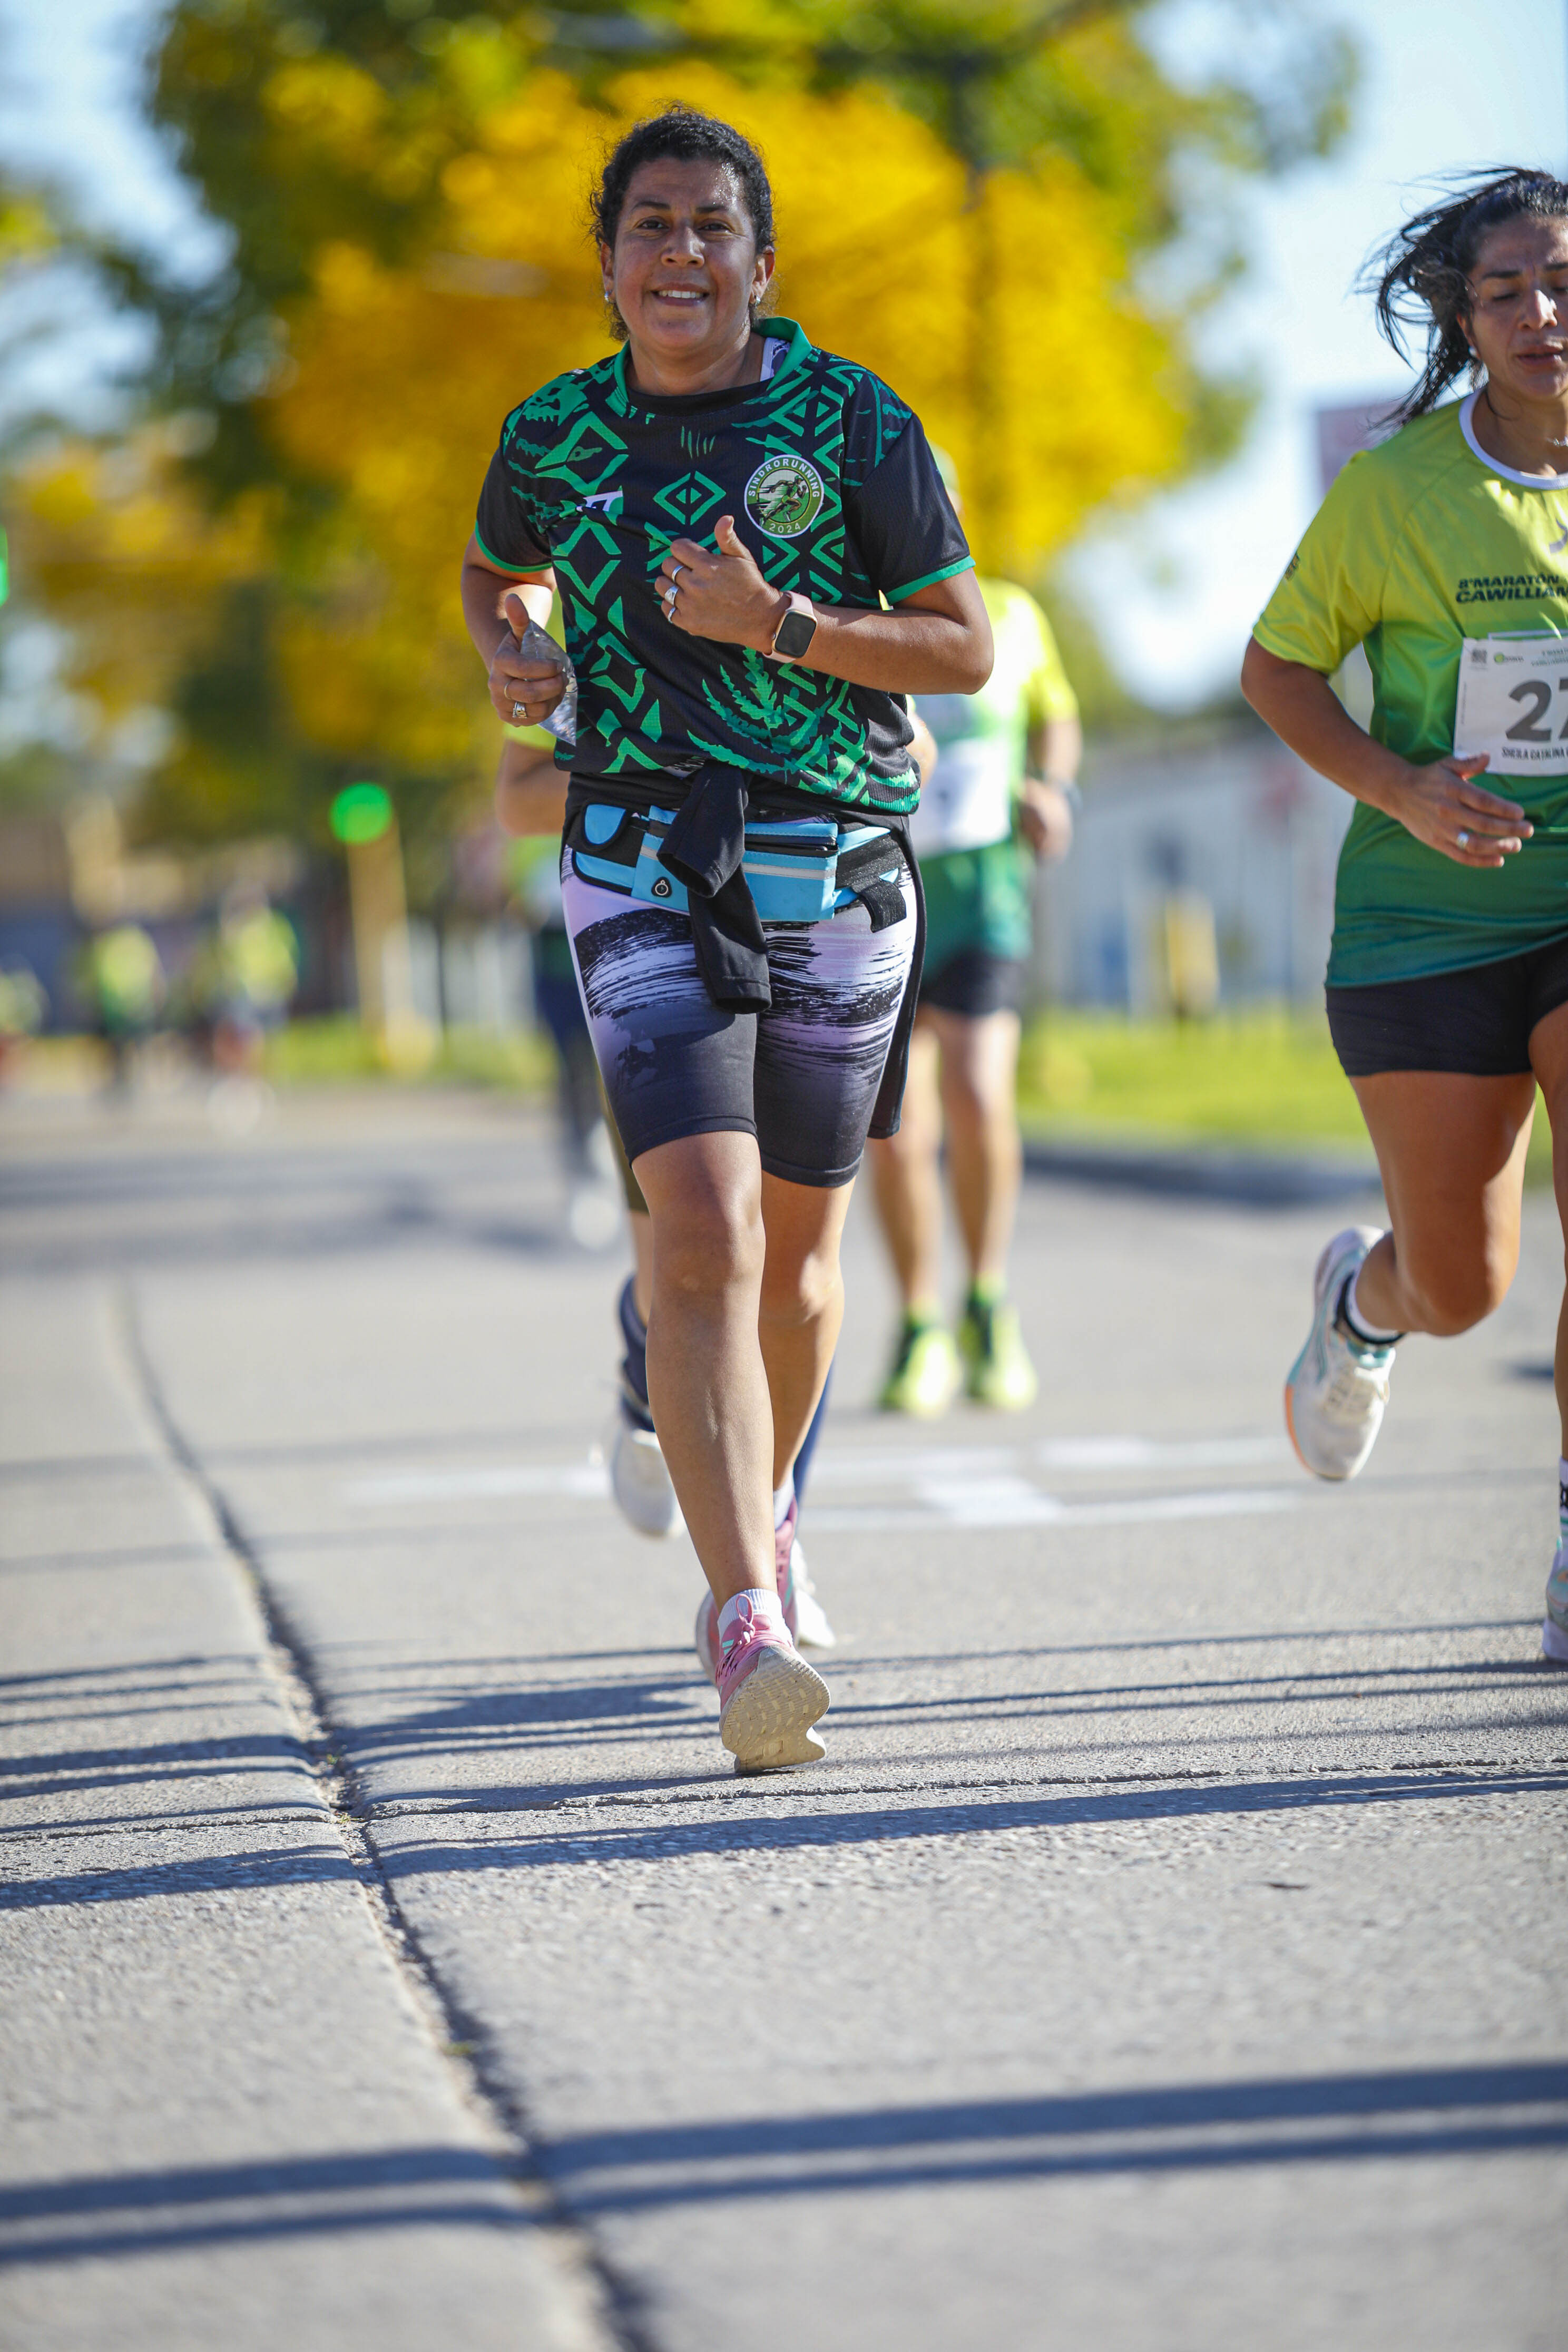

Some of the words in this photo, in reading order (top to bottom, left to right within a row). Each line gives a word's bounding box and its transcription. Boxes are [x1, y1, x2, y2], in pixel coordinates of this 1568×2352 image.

[749, 458, 820, 497] SINDRORUNNING
[769, 522, 801, 533] 2024
[1505, 678, 1568, 742] 2
